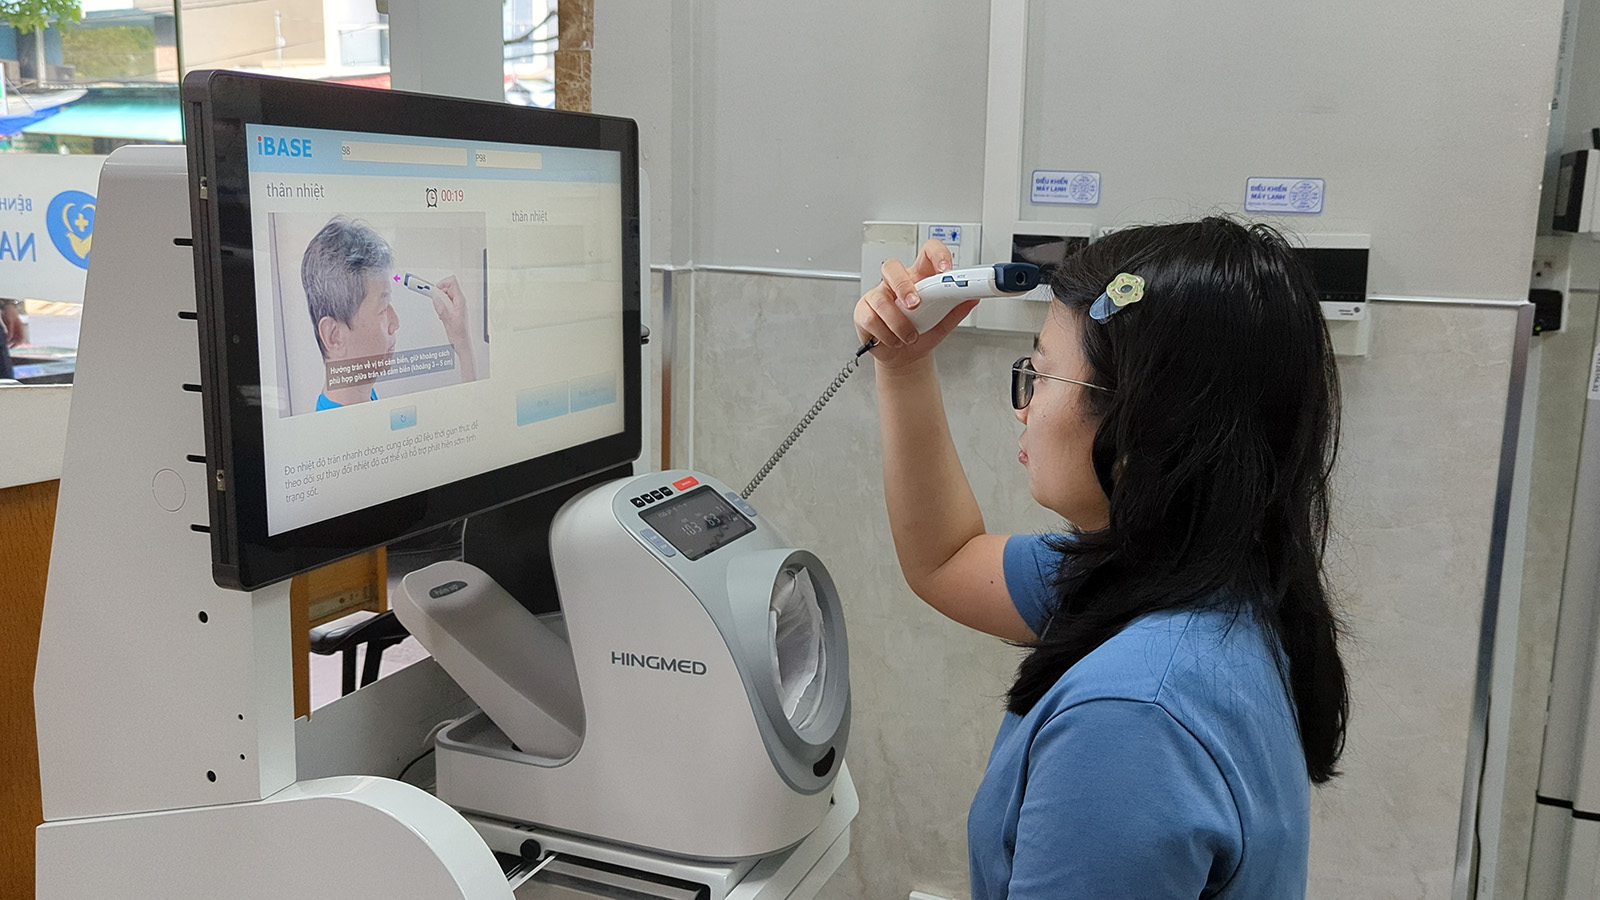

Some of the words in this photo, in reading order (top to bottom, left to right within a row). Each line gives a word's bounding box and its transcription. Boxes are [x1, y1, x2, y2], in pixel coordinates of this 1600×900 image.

[258, 136, 312, 157] iBASE
[341, 145, 351, 156] 98
[475, 153, 487, 163] P98
[266, 182, 293, 197] thân
[296, 183, 325, 200] nhiệt
[440, 188, 464, 203] 00:19
[512, 210, 528, 222] thân
[530, 210, 548, 224] nhiệt
[440, 359, 444, 367] 5
[284, 465, 296, 476] Đo
[342, 449, 363, 461] nhanh
[386, 441, 402, 451] cung
[285, 479, 302, 489] theo
[326, 469, 341, 479] thay
[611, 651, 707, 675] HINGMED
